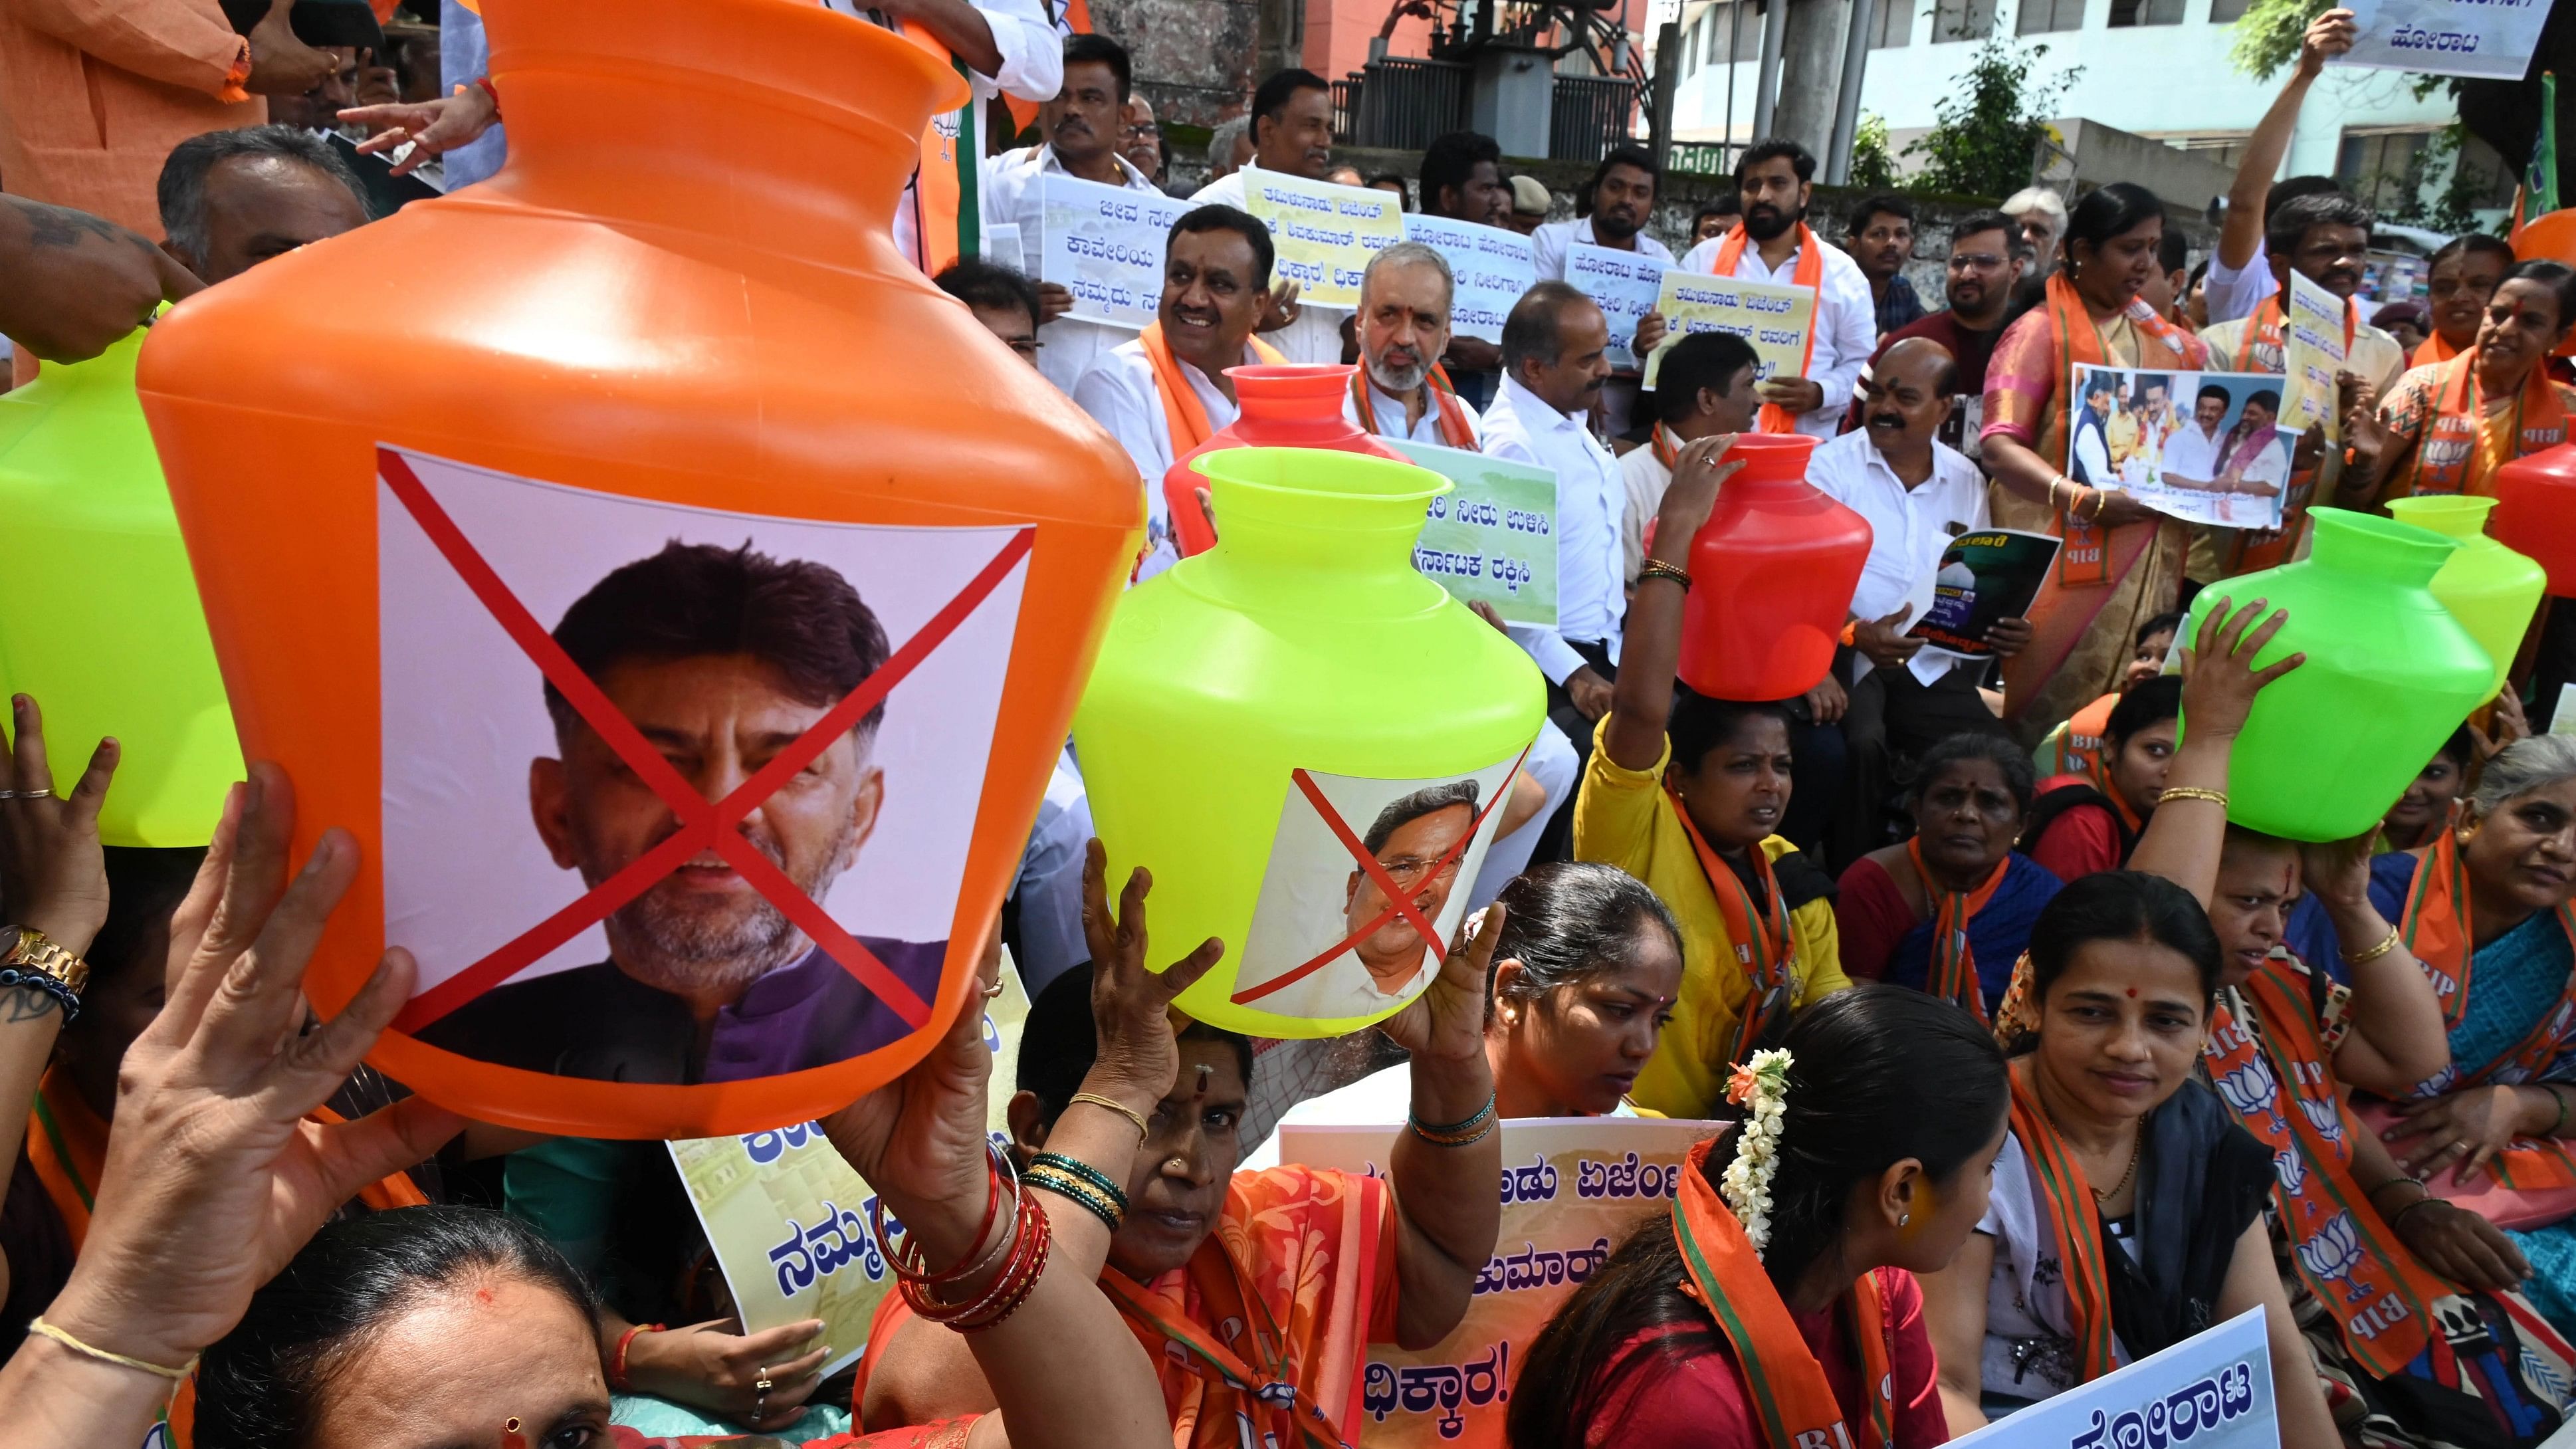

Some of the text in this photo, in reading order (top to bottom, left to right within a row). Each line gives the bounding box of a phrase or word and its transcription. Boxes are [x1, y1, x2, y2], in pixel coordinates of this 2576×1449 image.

[2391, 23, 2480, 53] ಹೋರಾಟ
[1100, 199, 1138, 223] ಜೀವ
[1410, 223, 1528, 262] ಹೋರಾಟ ಹೋರಾಟ
[1575, 253, 1630, 279] ಹೋರಾಟ
[1457, 499, 1498, 526] ನೀರು
[1507, 509, 1549, 535] ಉಳಿಸಿ
[1417, 545, 1483, 577] ರ್ನಾಟಕ
[1363, 1341, 1509, 1440] ಧಿಕ್ಕಾರ!
